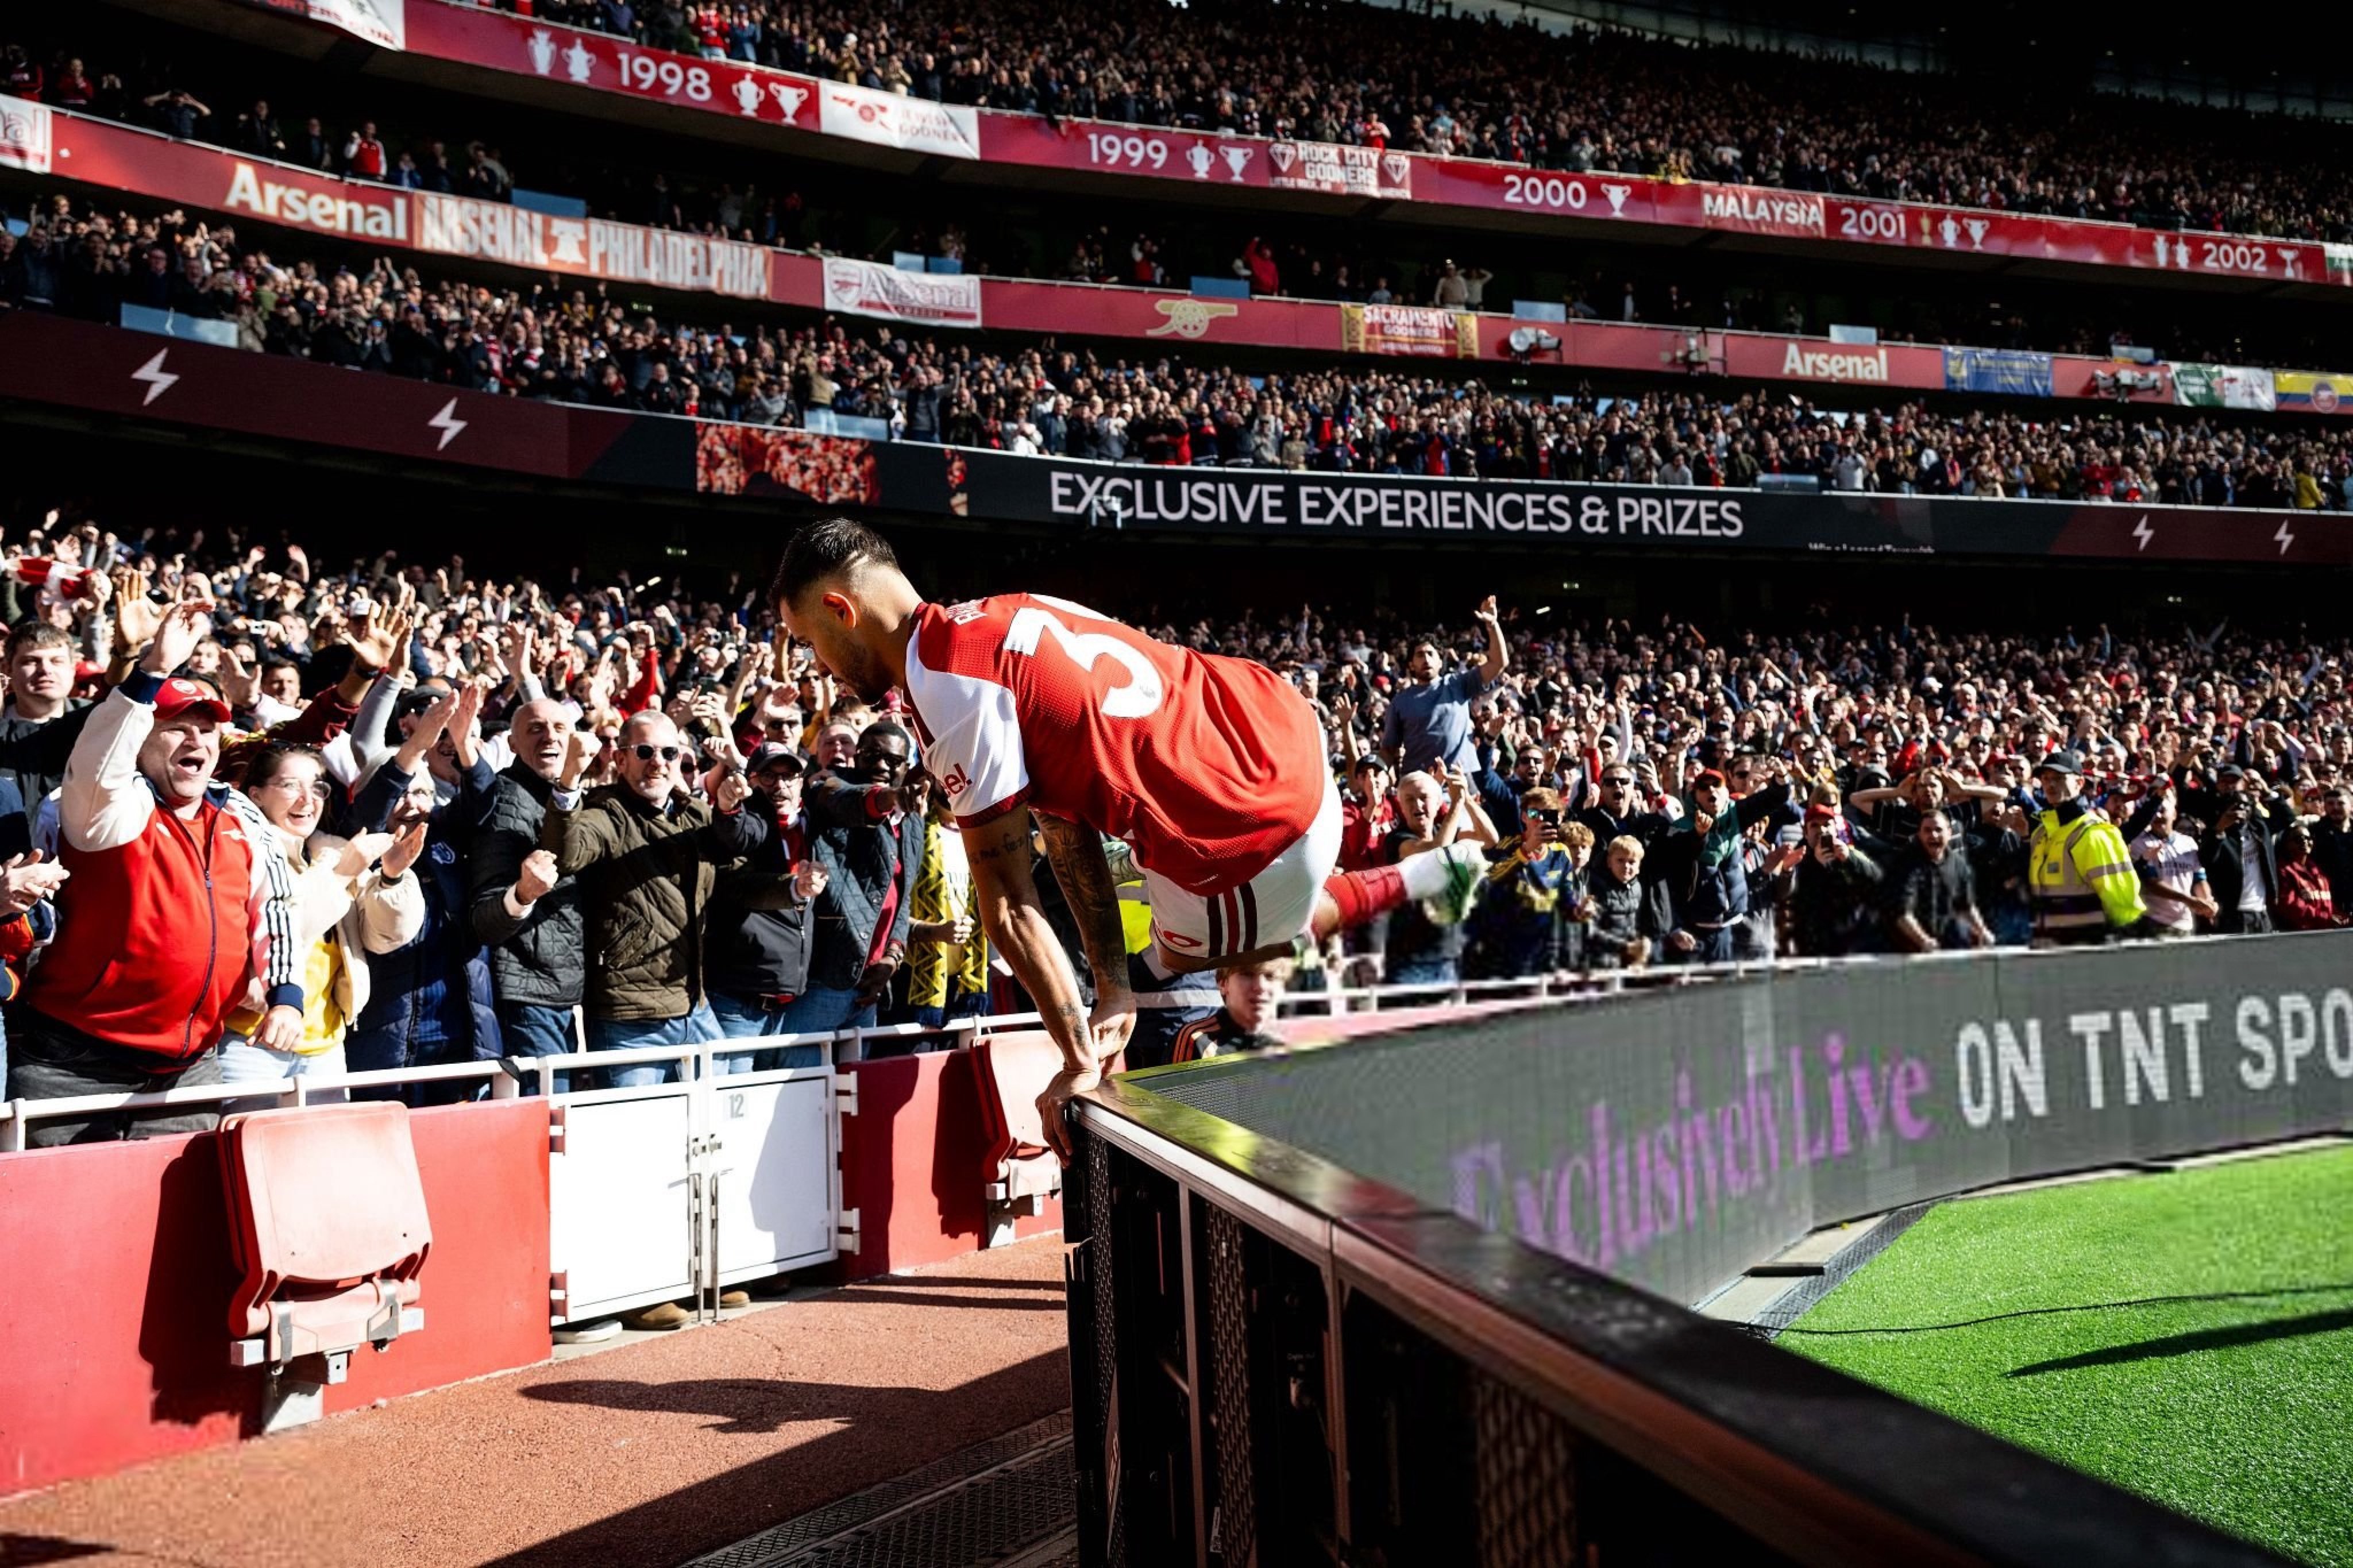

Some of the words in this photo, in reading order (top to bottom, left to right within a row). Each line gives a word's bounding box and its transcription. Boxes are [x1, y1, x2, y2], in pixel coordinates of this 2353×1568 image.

[618, 52, 712, 102] 1998
[1088, 133, 1168, 169] 1999
[1297, 142, 1340, 164] ROCK
[1344, 147, 1379, 168] CITY
[1305, 163, 1377, 185] GOONERS
[225, 163, 408, 241] Arsenal
[1503, 175, 1587, 208] 2000
[1703, 193, 1822, 227] MALAYSIA
[1841, 207, 1906, 240] 2001
[423, 196, 547, 265] ARSENAL
[589, 227, 767, 298] PHILADELPHIA
[2203, 242, 2267, 272] 2002
[1363, 305, 1455, 330] SACRAMENTO
[1783, 343, 1888, 381] Arsenal
[1050, 471, 1287, 524] EXCLUSIVE
[1300, 485, 1572, 532] EXPERIENCES
[1580, 496, 1610, 534] &
[1619, 497, 1743, 538] PRIZES
[1789, 1031, 1934, 1166] Live
[1957, 1019, 2048, 1127] ON
[2070, 1002, 2209, 1110] TNT
[2236, 987, 2353, 1090] SPO
[728, 1093, 744, 1118] 12
